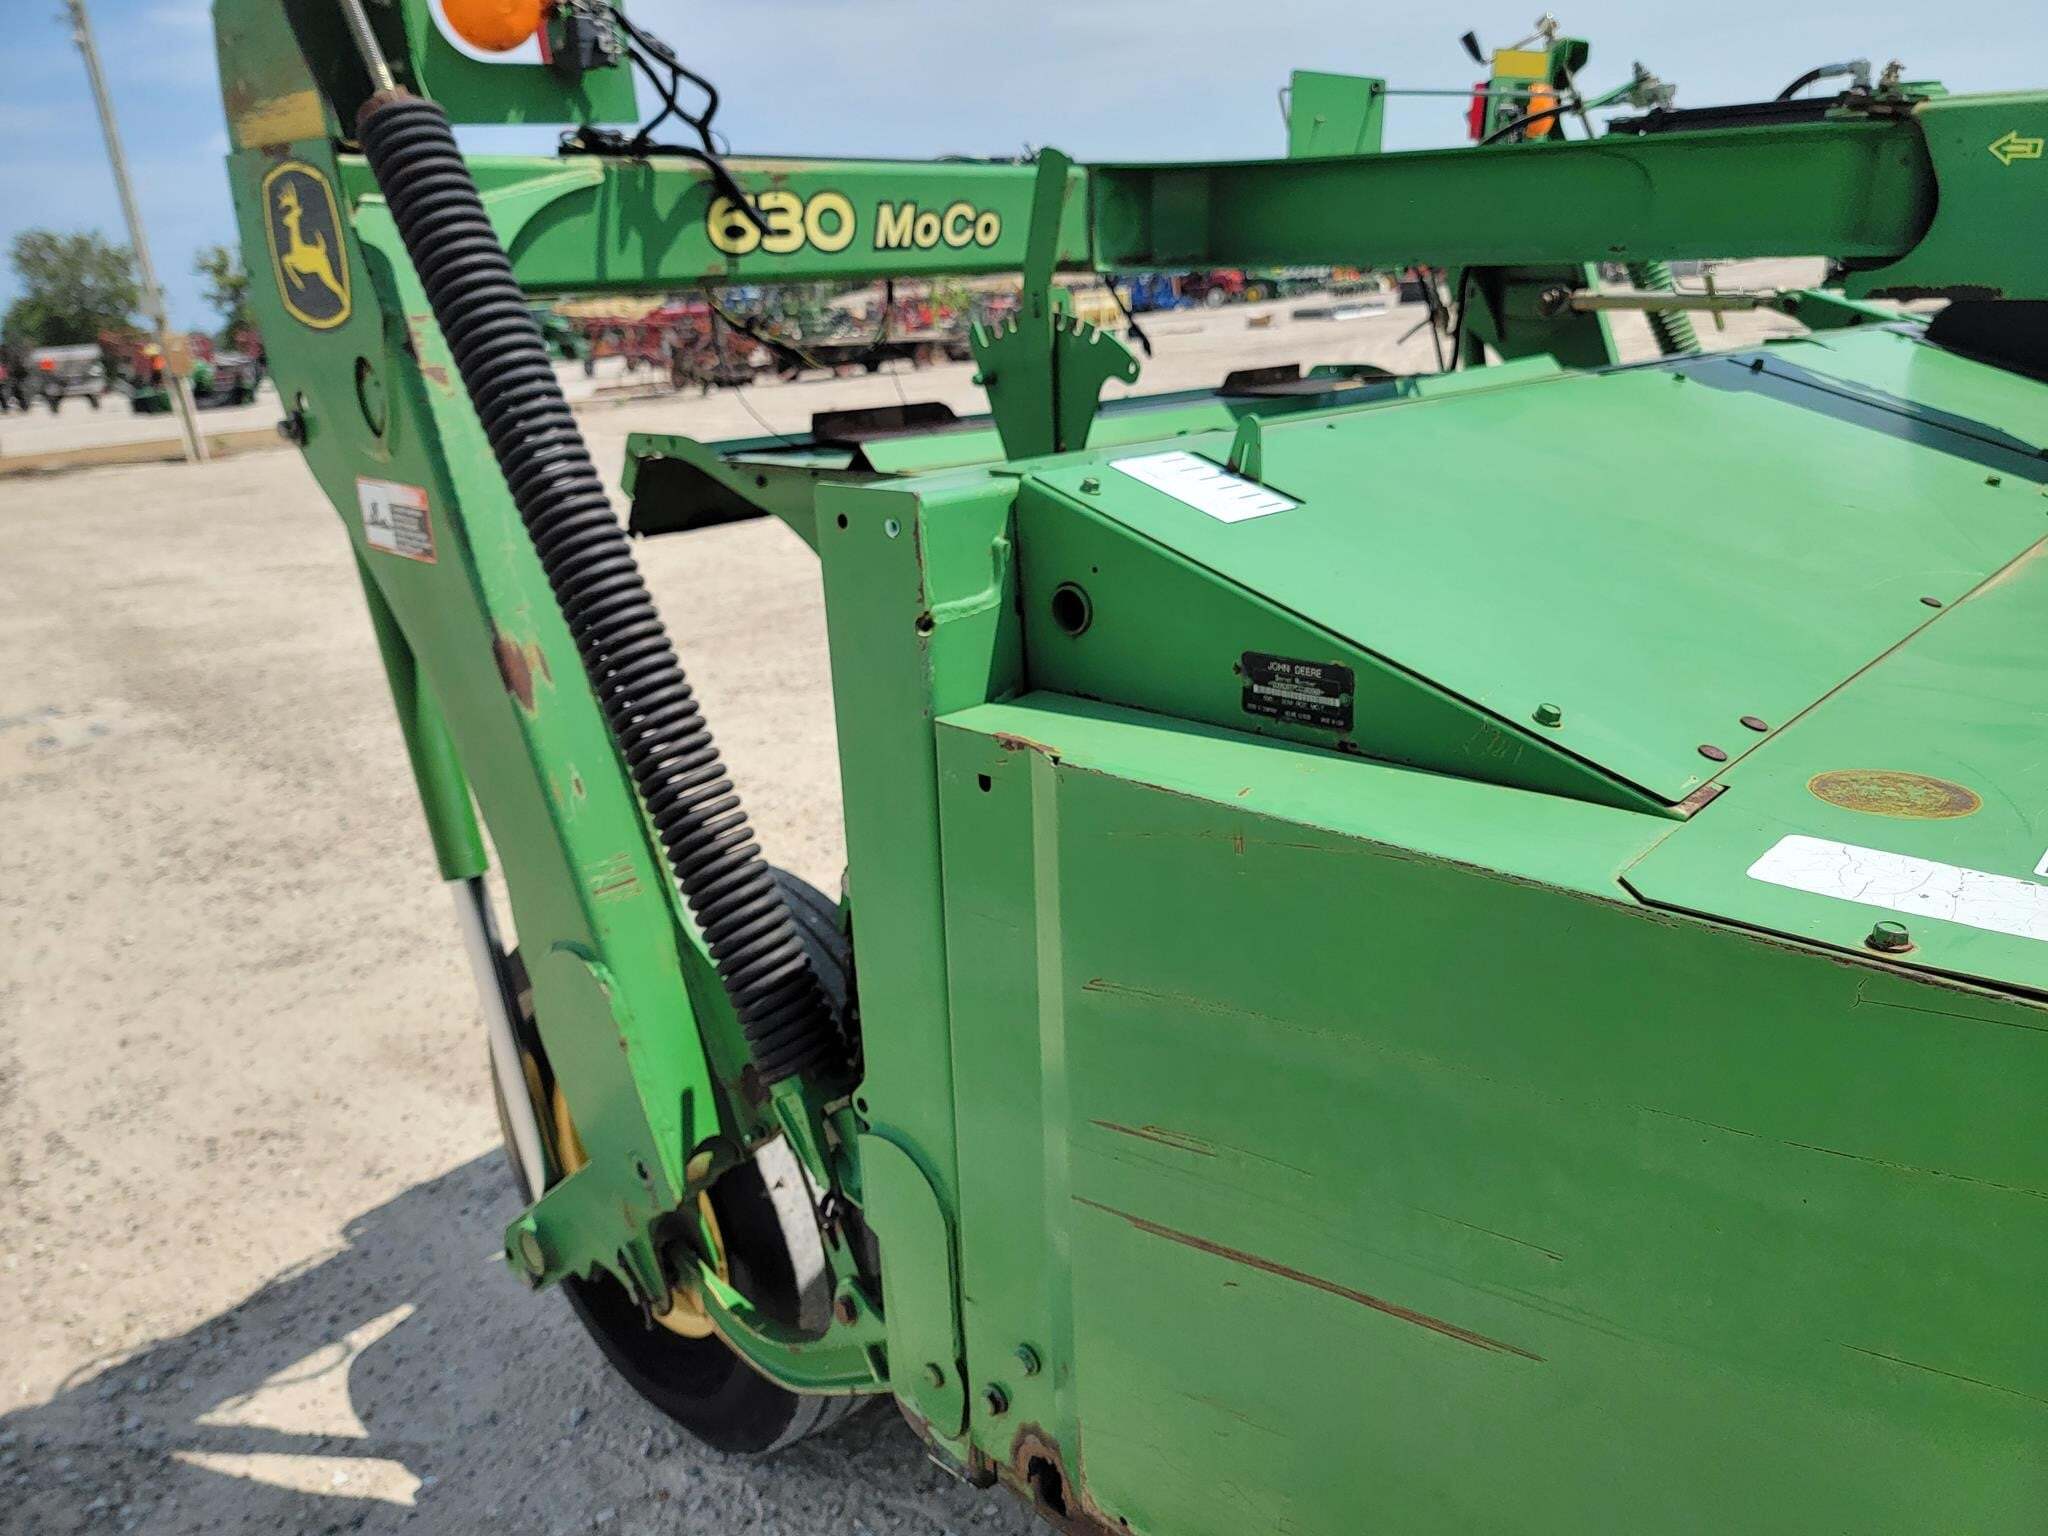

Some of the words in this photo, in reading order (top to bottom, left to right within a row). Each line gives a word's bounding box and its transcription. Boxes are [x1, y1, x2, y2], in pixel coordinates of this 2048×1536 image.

[706, 190, 857, 254] 630
[873, 200, 1001, 250] MoCo
[1268, 661, 1290, 674] JOHN
[1294, 664, 1323, 679] DEERE
